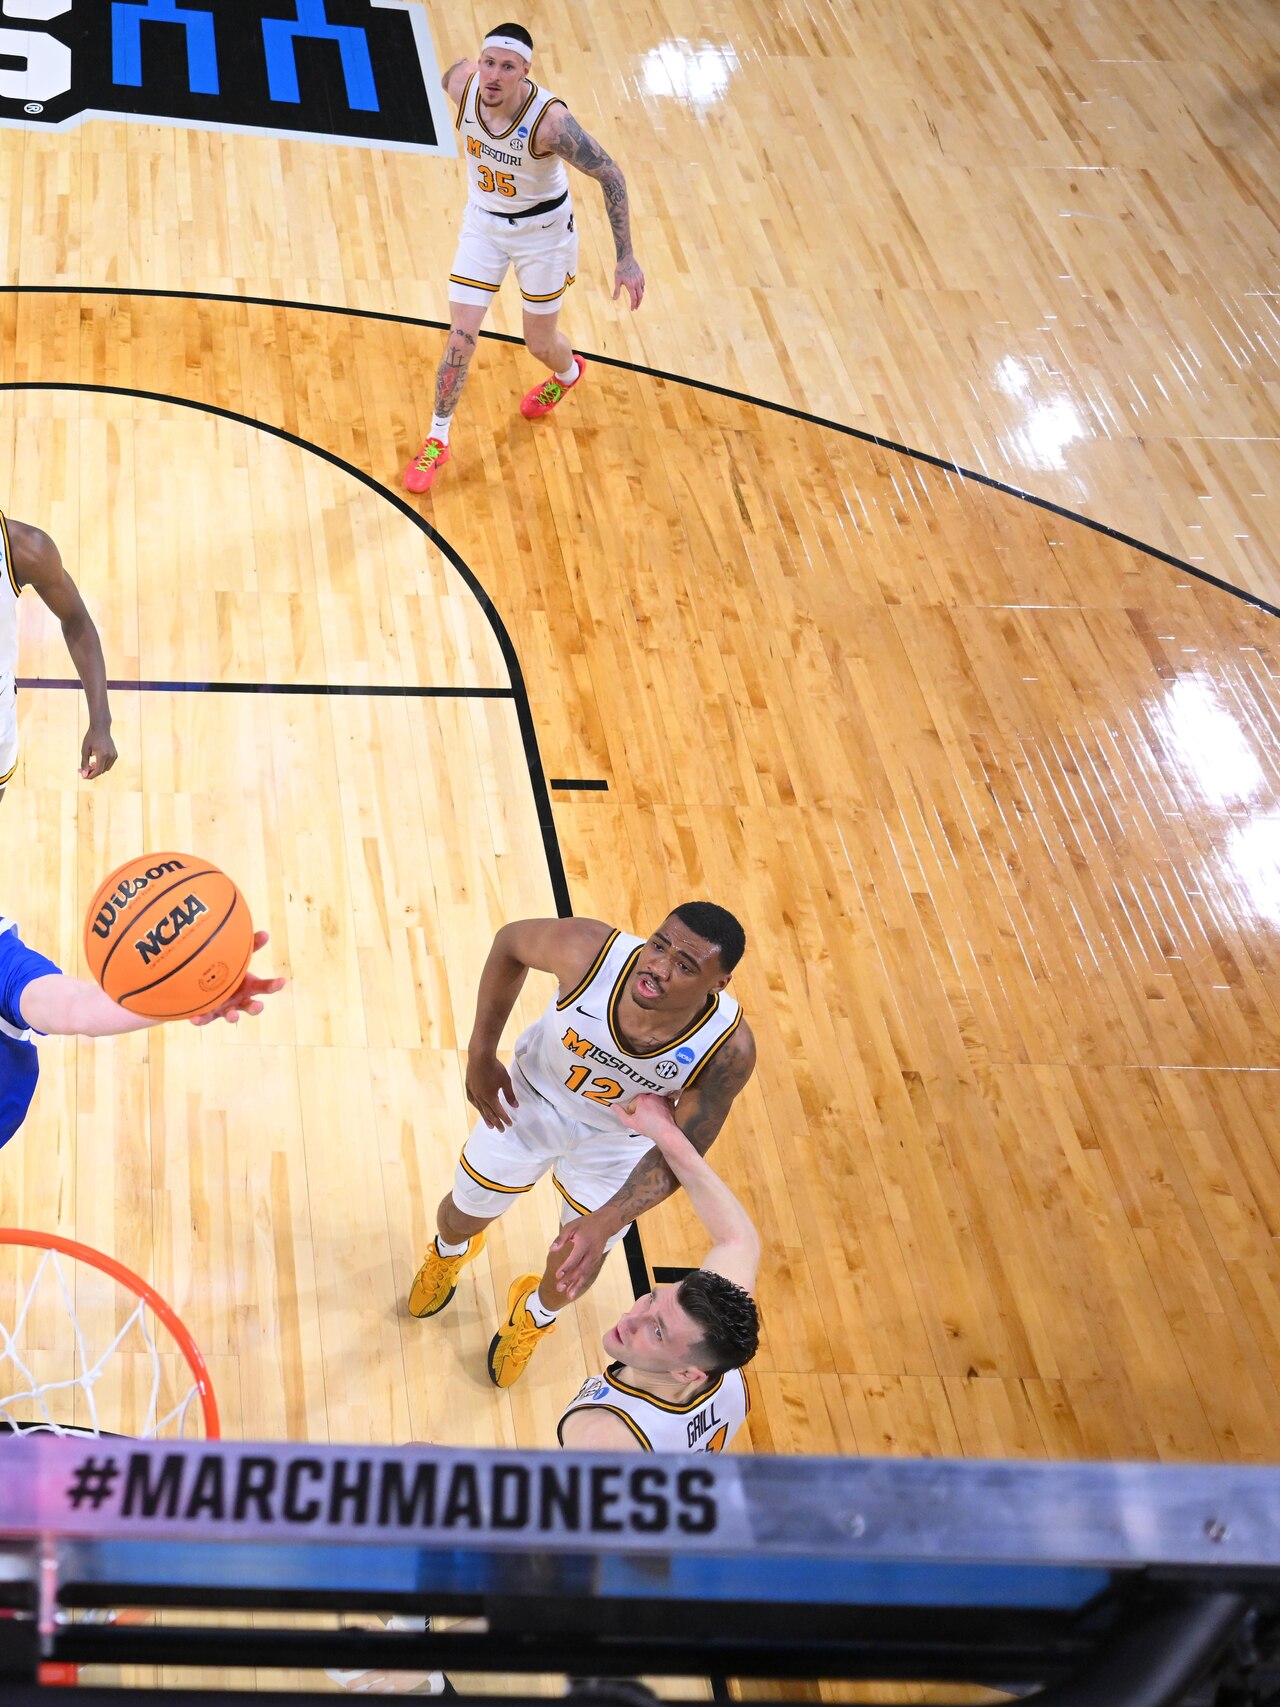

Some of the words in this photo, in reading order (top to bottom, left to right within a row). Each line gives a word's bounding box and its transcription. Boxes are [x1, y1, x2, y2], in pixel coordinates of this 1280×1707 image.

[467, 136, 521, 166] MISSOURI
[478, 165, 516, 197] 35
[92, 860, 186, 939] Wilson
[134, 894, 208, 965] NCAA
[561, 1026, 665, 1093] MISSOURI
[656, 1061, 678, 1079] SEC
[564, 1064, 624, 1107] 12
[686, 1402, 721, 1448] GRILL
[65, 1453, 718, 1534] #MARCHMADNESS
